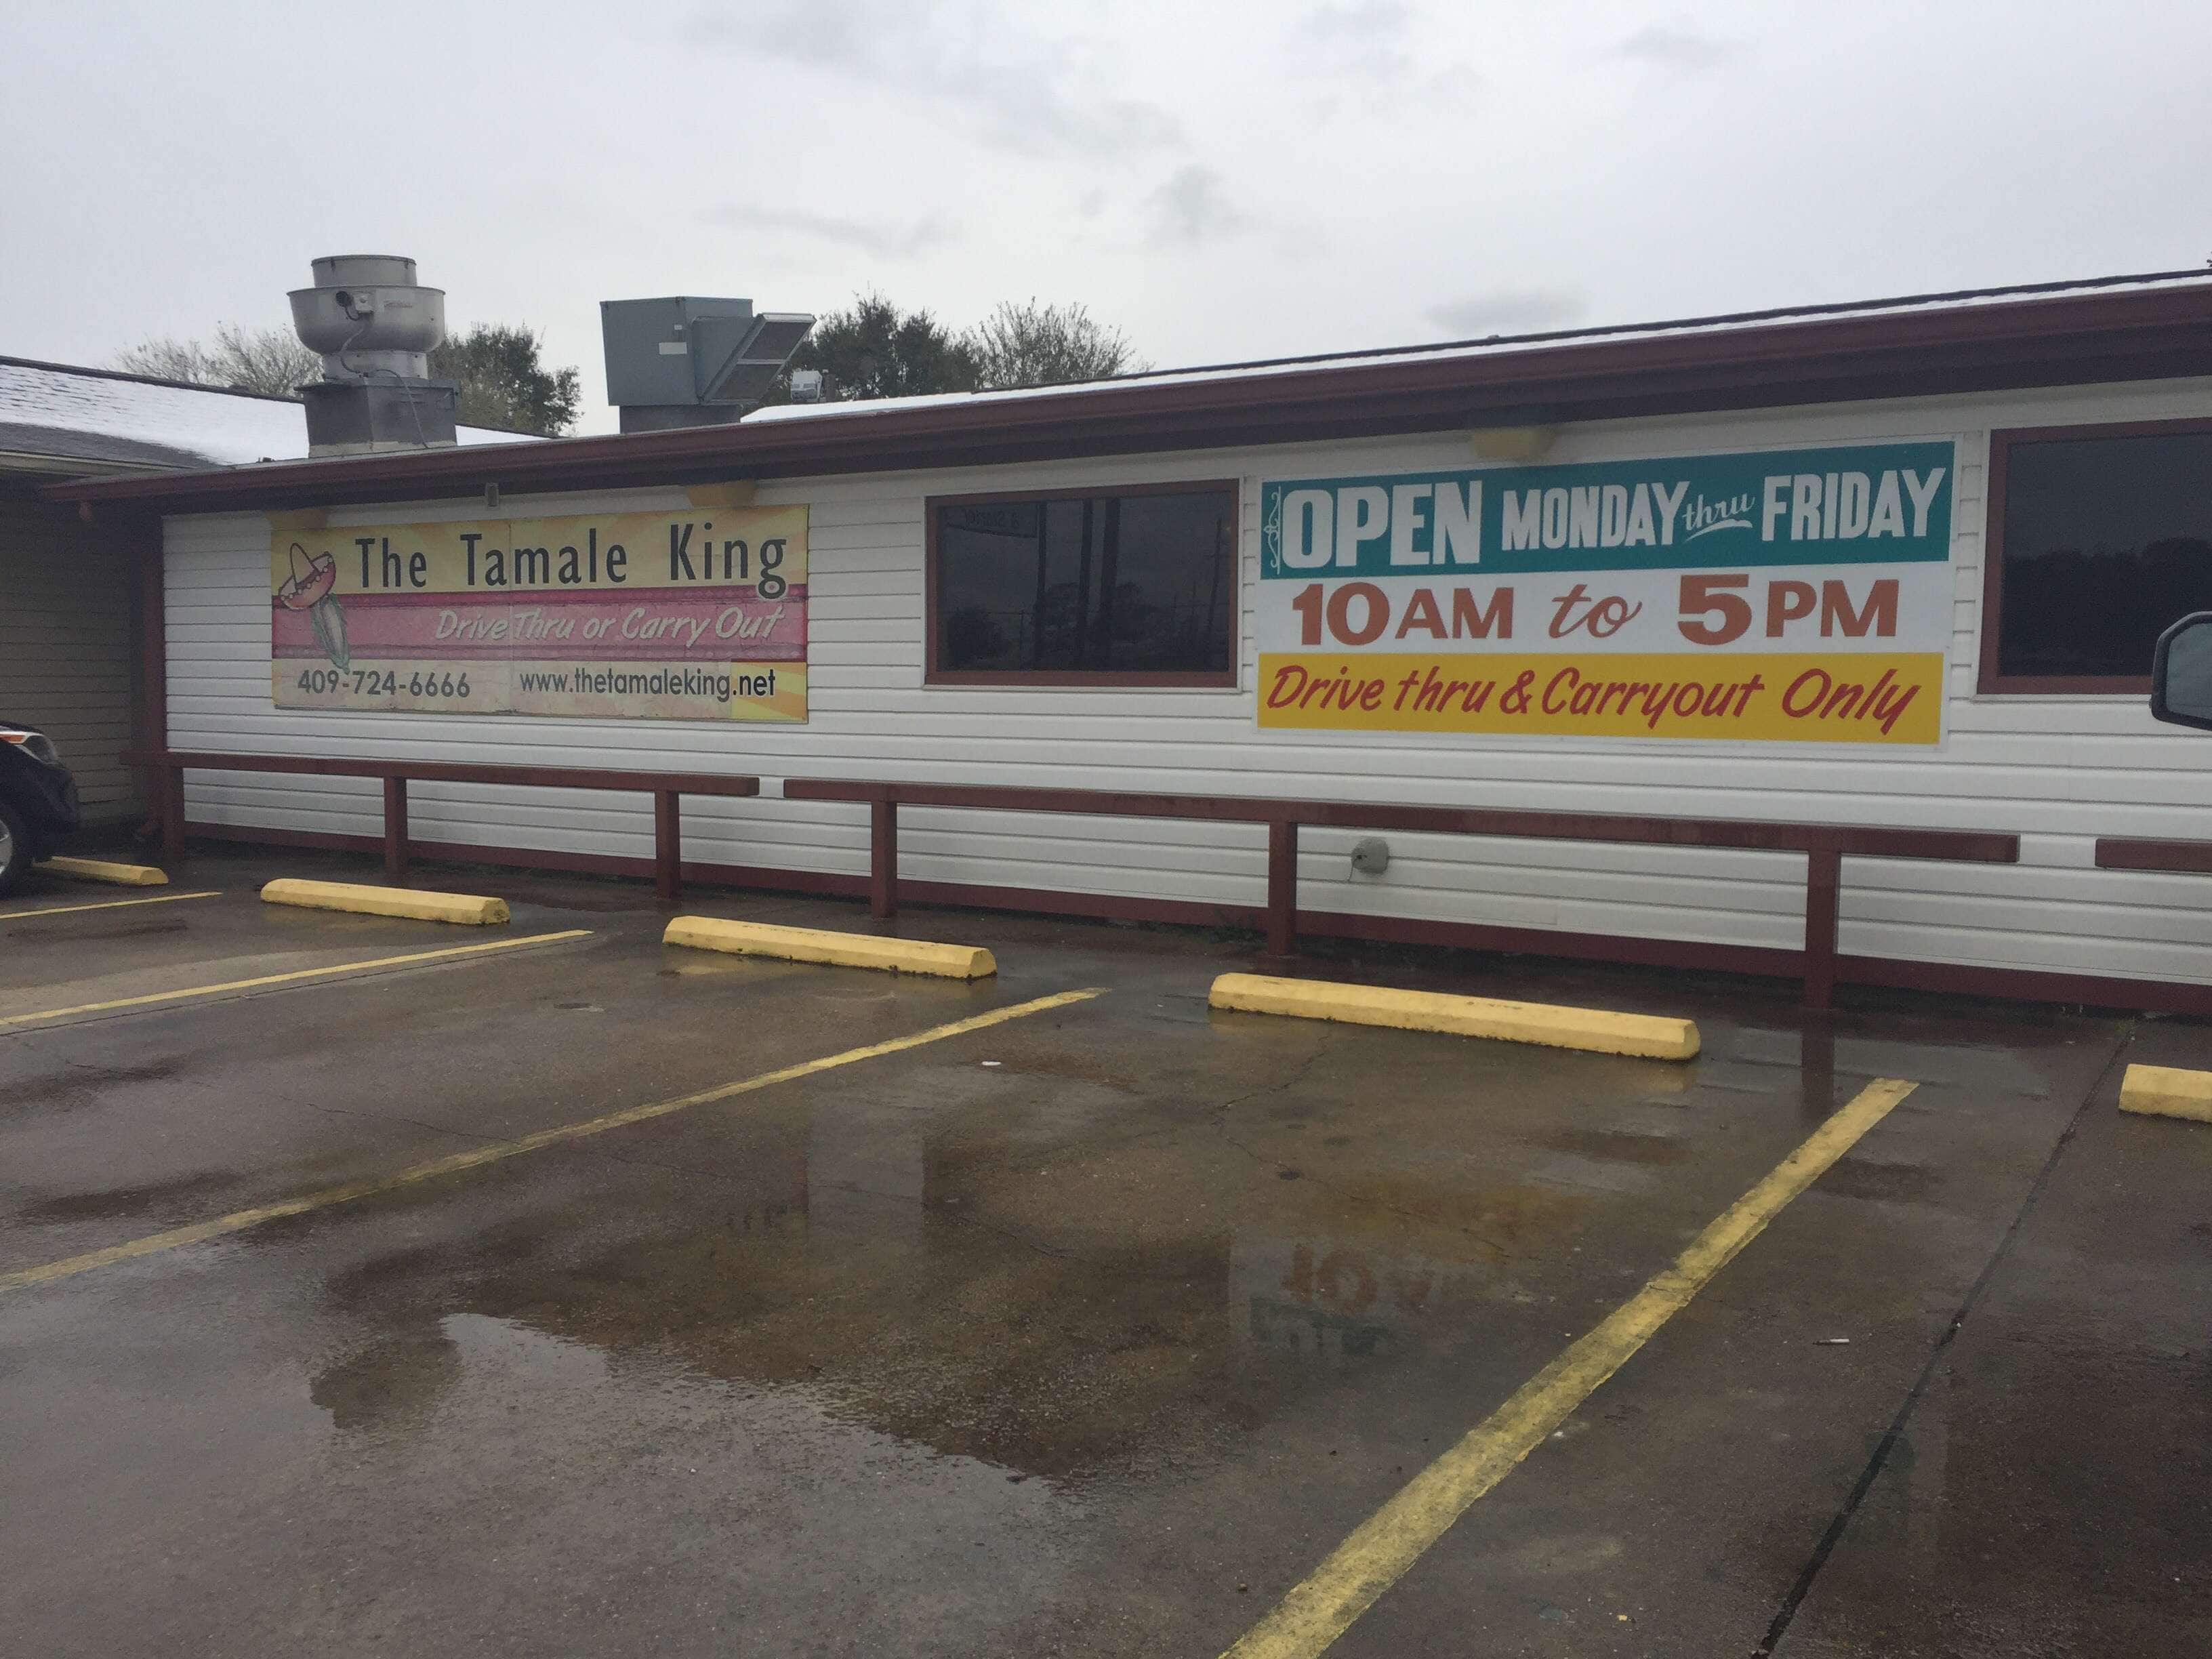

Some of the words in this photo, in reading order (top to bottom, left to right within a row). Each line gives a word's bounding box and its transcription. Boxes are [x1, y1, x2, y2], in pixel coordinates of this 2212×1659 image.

[1282, 480, 1482, 568] OPEN
[1502, 480, 1690, 550] MONDAY
[1682, 493, 1755, 531] thru
[1762, 468, 1946, 541] FRIDAY
[355, 537, 426, 588] The
[460, 529, 627, 587] Tamale
[670, 523, 787, 598] King
[435, 609, 510, 640] Drive
[514, 609, 575, 640] Thru
[582, 616, 617, 639] or
[621, 607, 711, 648] Carry
[715, 605, 786, 640] Out
[1292, 581, 1514, 646] 10AM
[1549, 583, 1642, 638] to
[298, 669, 471, 698] 409-724-6666
[520, 668, 776, 703] www.thetamaleking.net
[1266, 664, 1385, 711] Drive
[1393, 665, 1496, 713] thru
[1500, 670, 1536, 714] &
[1541, 667, 1765, 730] Carryout
[1782, 668, 1921, 735] Only
